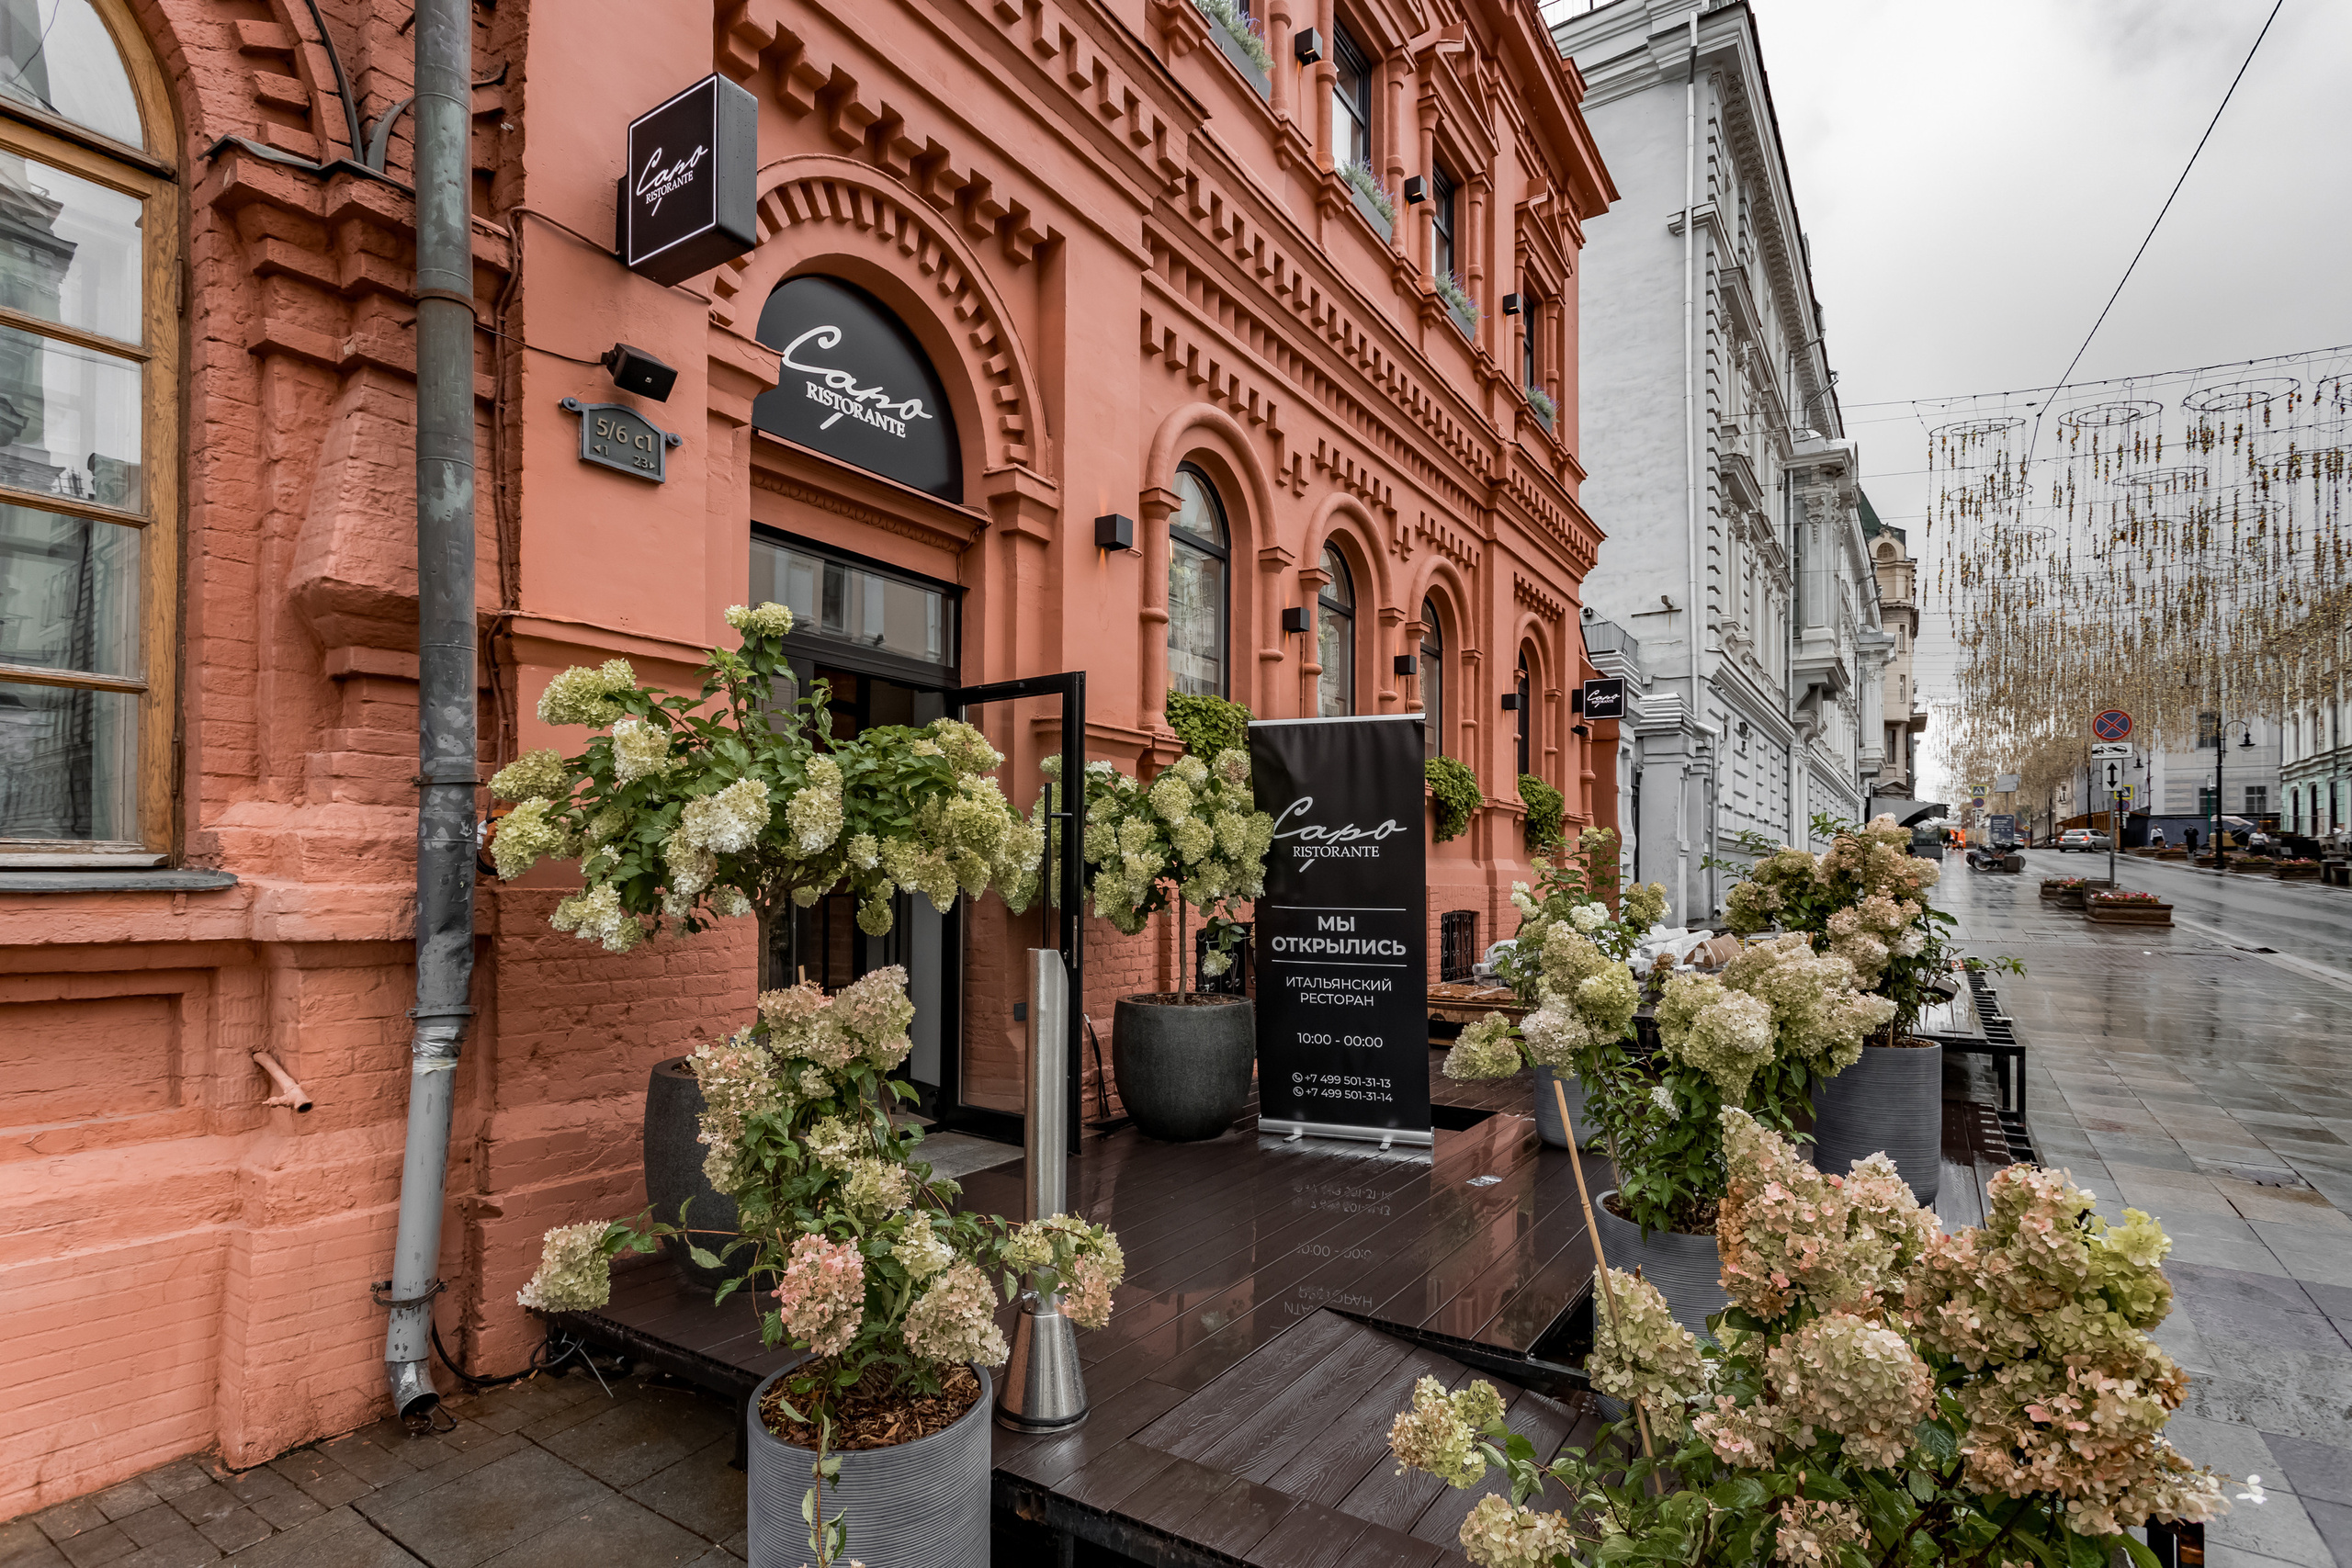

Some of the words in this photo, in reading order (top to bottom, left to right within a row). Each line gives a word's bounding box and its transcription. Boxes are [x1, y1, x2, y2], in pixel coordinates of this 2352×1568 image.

[636, 144, 709, 217] Capo
[645, 170, 694, 205] RISTORANTE
[781, 324, 933, 431] Capo
[805, 380, 906, 438] RISTORANTE
[596, 417, 628, 444] 5/6
[604, 445, 608, 457] 1
[633, 455, 648, 468] 23
[1587, 689, 1621, 708] Capo
[1273, 796, 1408, 873] Capo
[1292, 845, 1380, 858] RISTORANTE
[1317, 916, 1355, 932] МЫ
[1272, 936, 1407, 955] ОТКРЫЛИСЬ
[1285, 976, 1392, 992] ИТАЛЬЯНСКИЙ
[1300, 992, 1374, 1007] РЕСТОРАН
[1296, 1032, 1332, 1045] 10:00
[1343, 1035, 1384, 1048] 00:00
[1305, 1074, 1317, 1083] +7
[1320, 1075, 1341, 1085] 499
[1343, 1076, 1391, 1089] 501-31-13
[1306, 1088, 1318, 1097] +7
[1321, 1089, 1342, 1099] 499
[1344, 1089, 1394, 1102] 501-31-14
